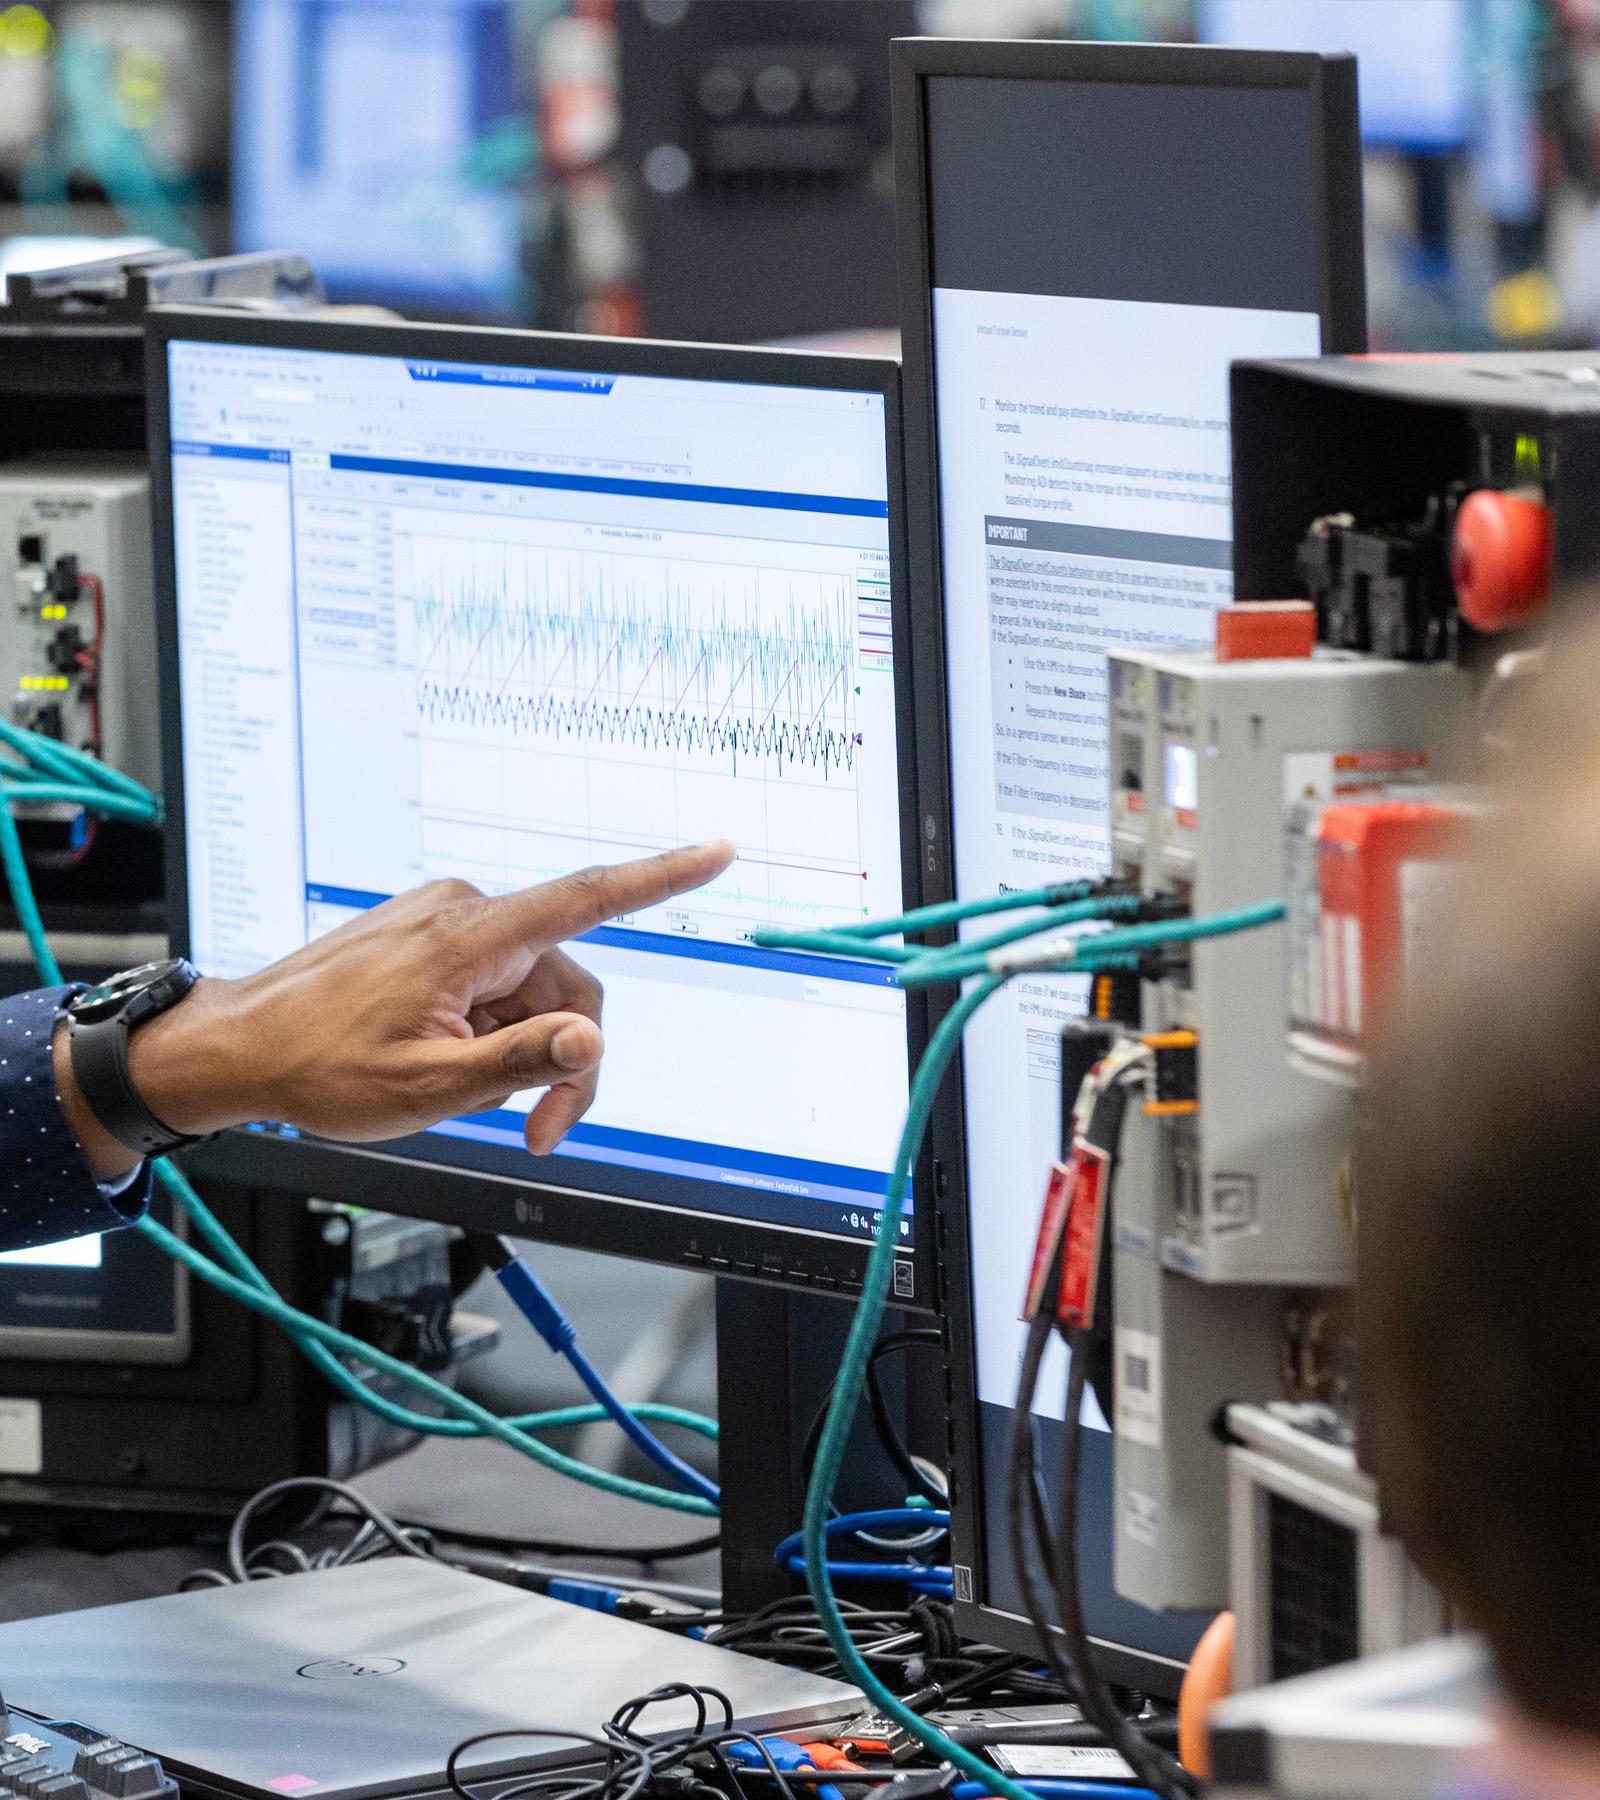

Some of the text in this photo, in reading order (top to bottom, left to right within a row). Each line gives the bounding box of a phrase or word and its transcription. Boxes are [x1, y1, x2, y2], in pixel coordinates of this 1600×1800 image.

[996, 399, 1016, 411] Monitor
[1018, 401, 1028, 412] the
[1029, 402, 1044, 414] trend
[1046, 403, 1056, 415] and
[1058, 408, 1069, 420] pay
[1070, 406, 1096, 419] attention
[996, 420, 1022, 433] seconds.
[1004, 452, 1014, 464] The
[1004, 472, 1036, 490] Monitoring
[1048, 477, 1070, 490] detects
[1072, 479, 1083, 491] that
[1084, 480, 1094, 492] the
[1096, 481, 1114, 498] torque
[1033, 496, 1052, 511] torque
[988, 524, 1028, 542] IMPORTANT
[990, 555, 1000, 568] The
[990, 577, 1004, 587] were
[1006, 577, 1030, 589] selected
[1041, 580, 1052, 592] this
[1053, 581, 1079, 594] exercise
[1087, 585, 1101, 597] work
[1102, 586, 1116, 598] with
[1117, 588, 1127, 599] the
[1006, 597, 1018, 609] may
[1019, 596, 1034, 608] need
[1042, 598, 1050, 610] be
[1051, 599, 1072, 615] slightly
[992, 612, 997, 623] In
[1022, 615, 1032, 627] the
[1033, 616, 1046, 628] New
[1048, 618, 1064, 630] Blade
[1066, 620, 1084, 632] should
[1086, 622, 1100, 634] have
[998, 631, 1006, 642] the
[1024, 657, 1036, 669] Use
[1036, 658, 1046, 670] the
[1047, 659, 1058, 672] HMI
[1025, 681, 1086, 699] Press the New Blade
[1026, 705, 1048, 721] Repeat
[1048, 707, 1058, 720] the
[1059, 711, 1082, 725] process
[1018, 727, 1039, 742] general
[1060, 734, 1068, 743] we
[1070, 735, 1080, 745] are
[1002, 752, 1012, 764] the
[1013, 753, 1028, 766] Filter
[1030, 755, 1060, 773] Frequency
[1004, 784, 1012, 796] the
[1014, 785, 1029, 798] Filter
[1030, 787, 1062, 805] Frequency
[1017, 826, 1026, 838] the
[928, 844, 936, 872] LG
[1012, 847, 1024, 858] next
[1026, 849, 1038, 863] step
[1048, 852, 1070, 864] observe
[1072, 854, 1082, 865] the
[1018, 1002, 1028, 1013] the
[720, 1172, 753, 1184] Communication
[776, 1181, 798, 1194] FactoryTalk
[528, 1204, 544, 1222] LG
